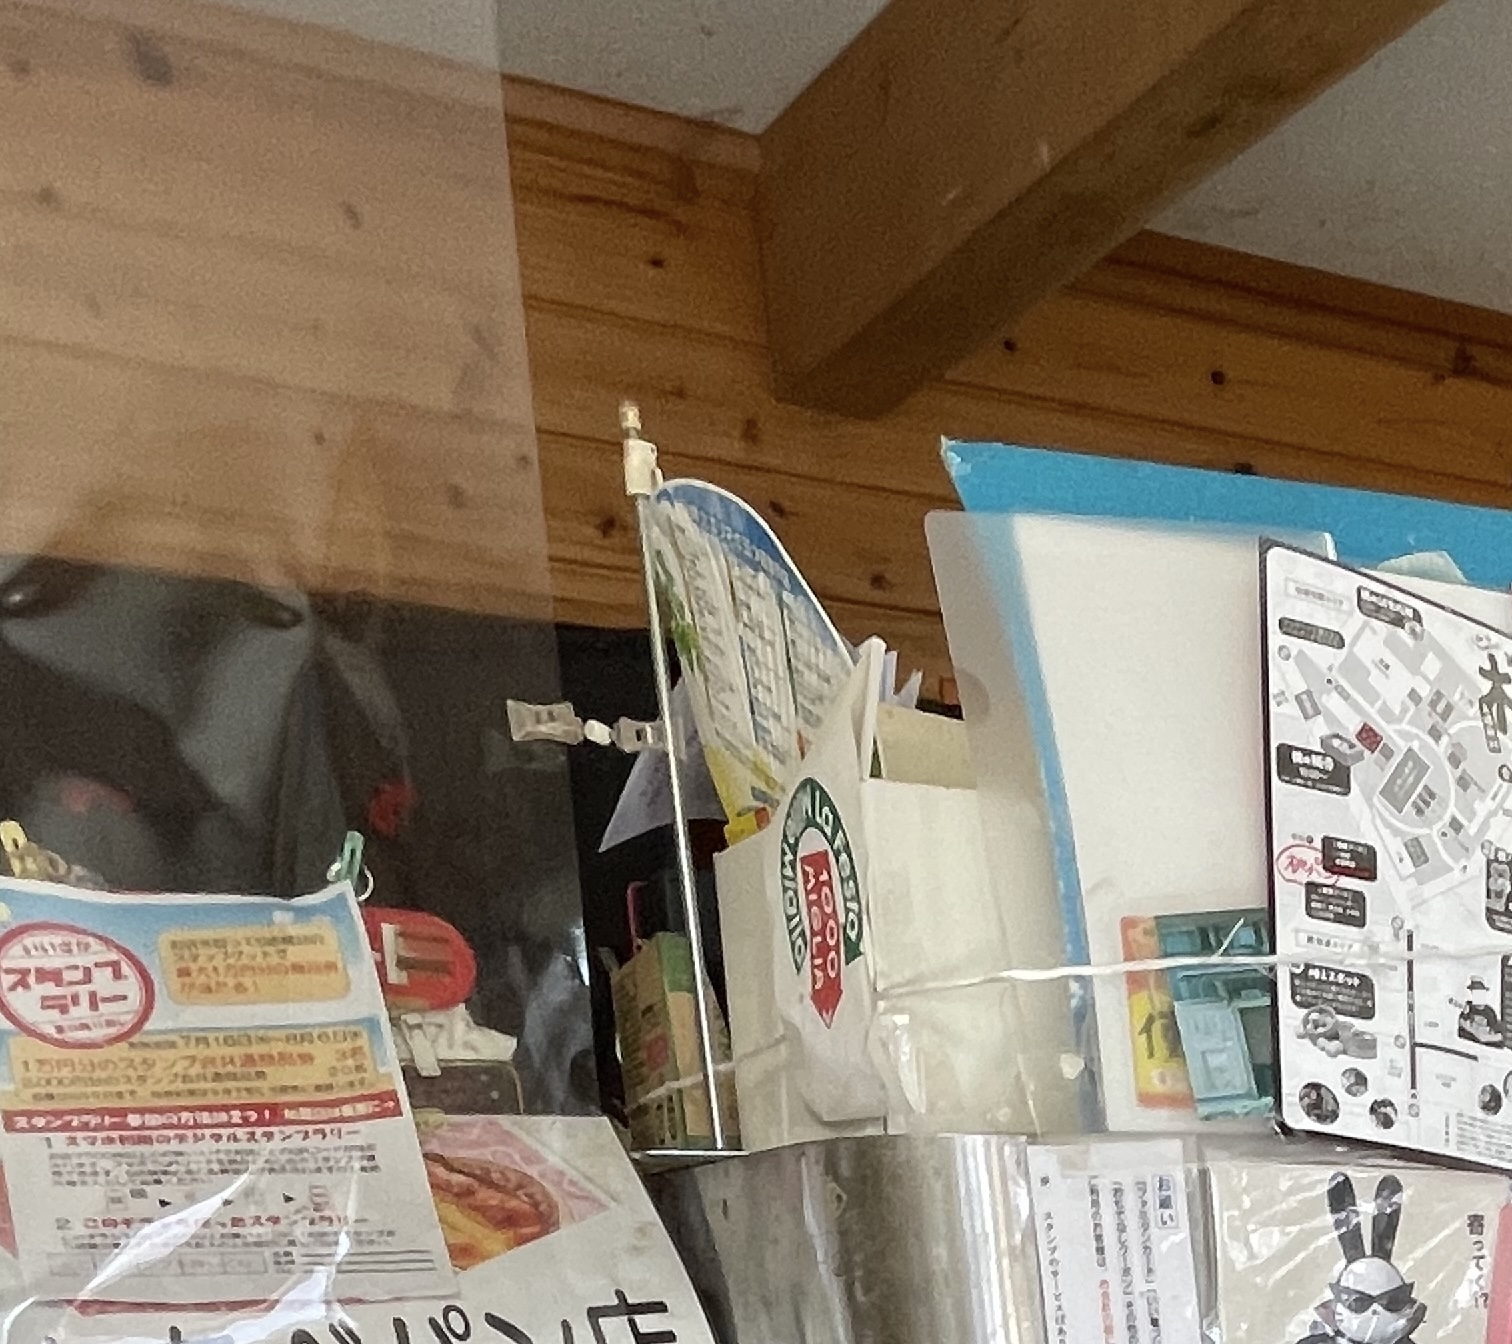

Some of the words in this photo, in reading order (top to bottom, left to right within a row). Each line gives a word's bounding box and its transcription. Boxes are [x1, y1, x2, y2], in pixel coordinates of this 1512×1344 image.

[818, 869, 838, 979] 1000
[40, 991, 128, 1015] ラリー
